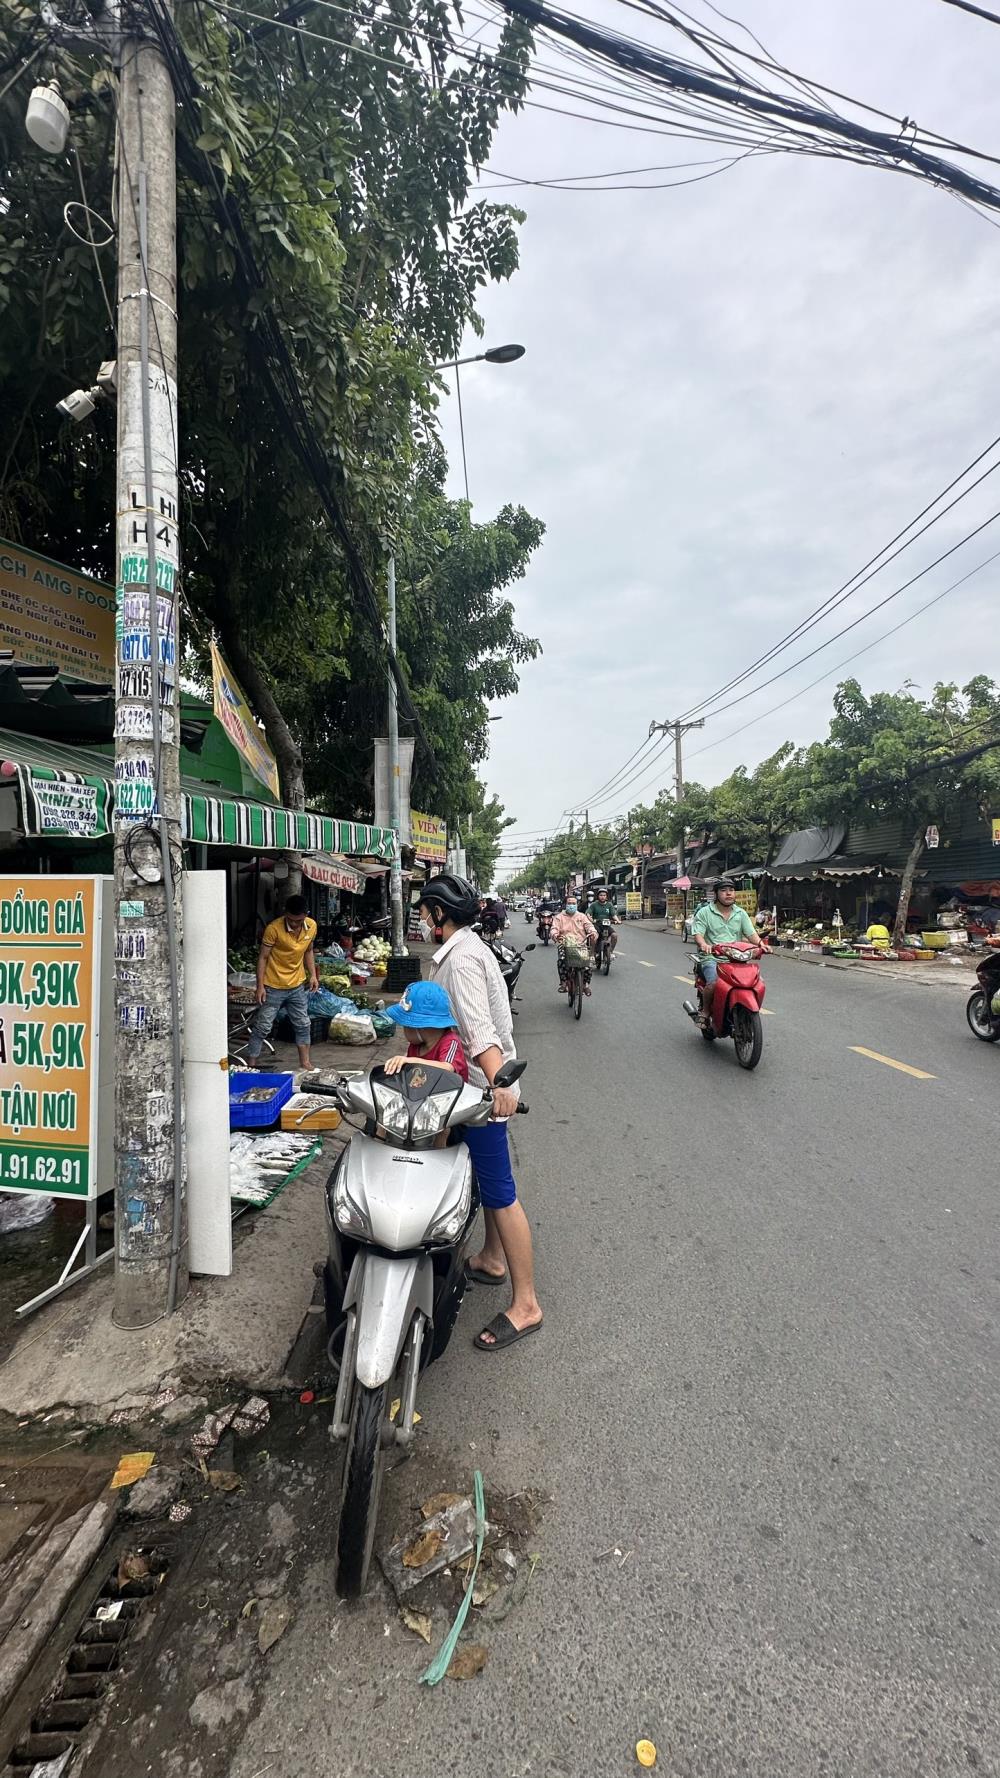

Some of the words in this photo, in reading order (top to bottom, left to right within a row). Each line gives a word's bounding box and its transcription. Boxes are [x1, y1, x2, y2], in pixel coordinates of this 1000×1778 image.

[33, 570, 73, 595] AMG
[311, 865, 328, 882] RAU
[1, 888, 49, 934] ĐỒNG
[54, 892, 85, 934] GIÁ
[12, 1023, 85, 1072] 5K,9K
[1, 1083, 37, 1133] TẬN
[43, 1090, 76, 1130] NƠI
